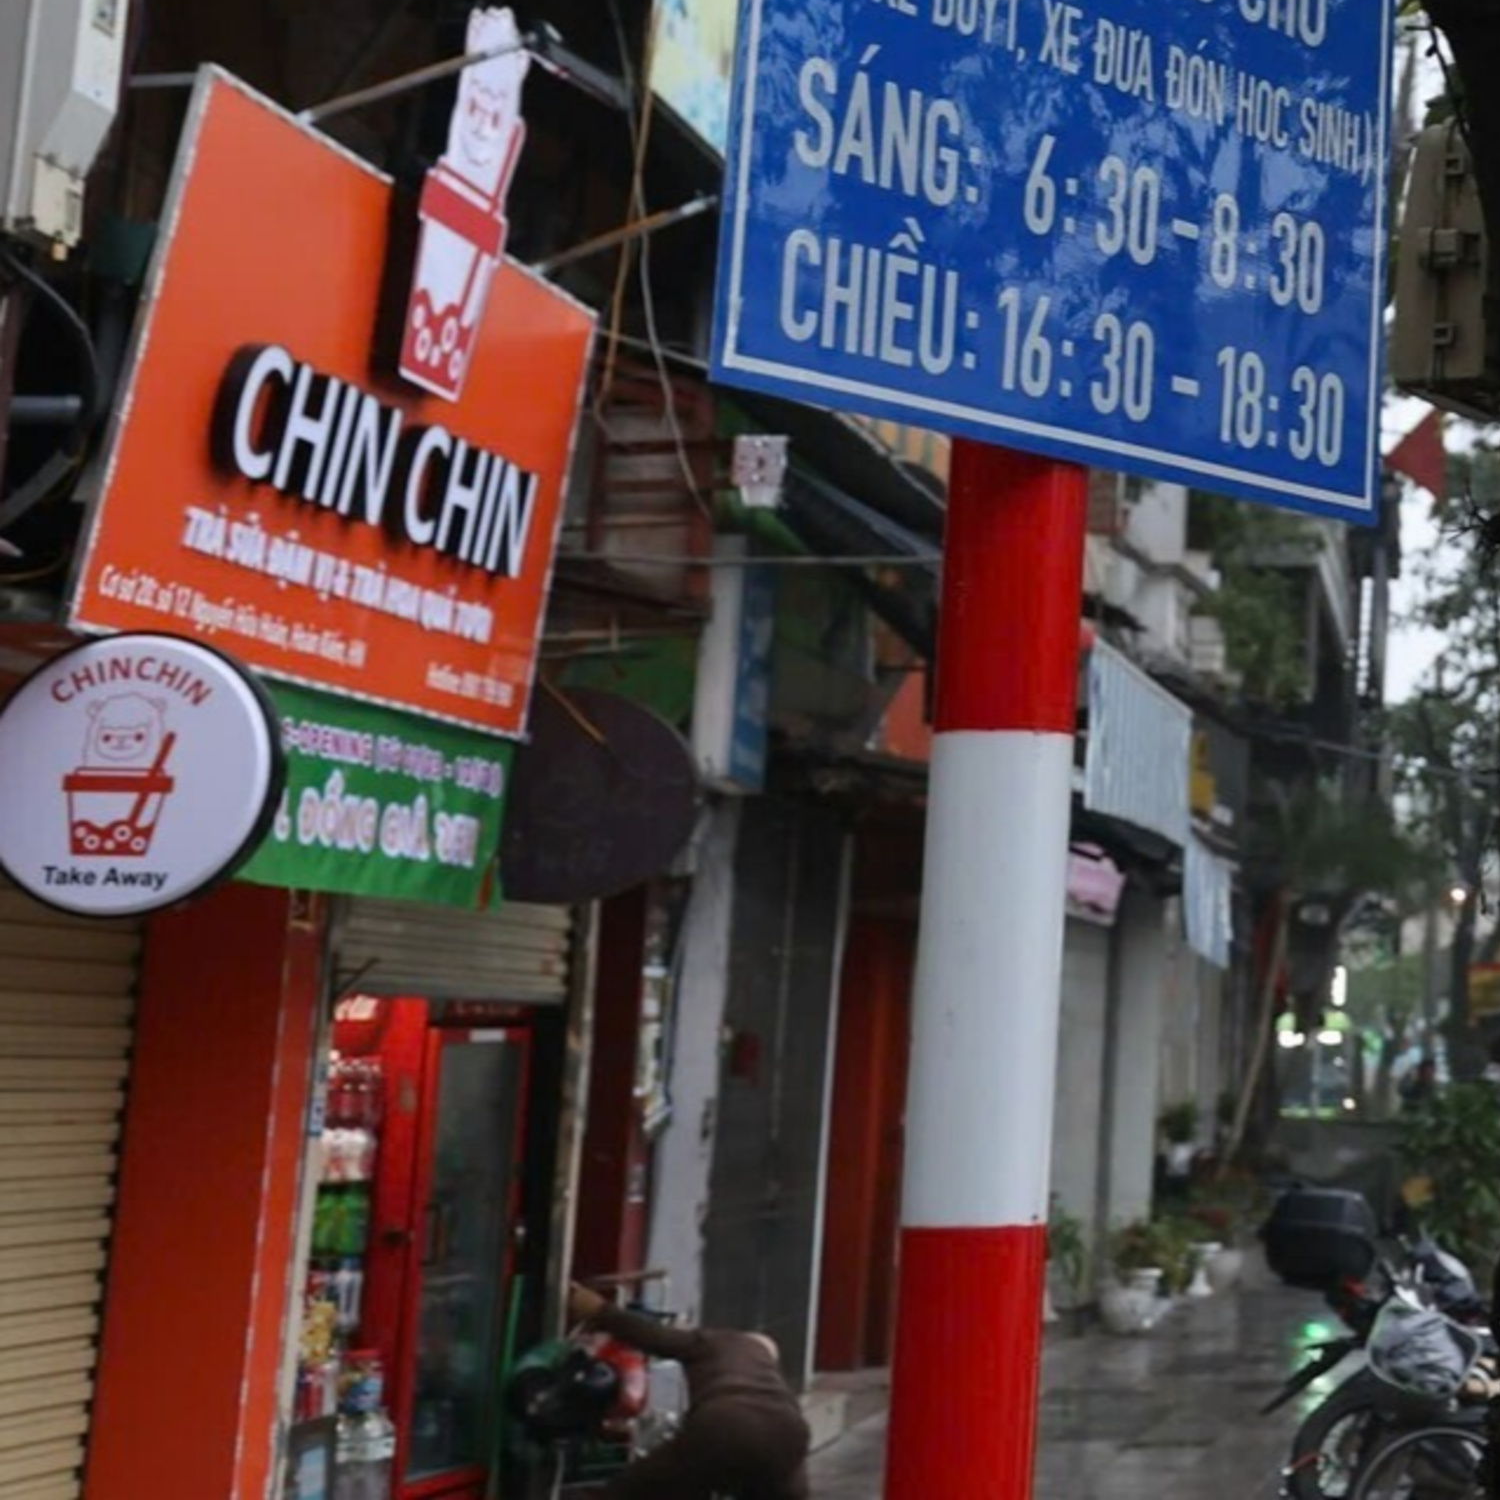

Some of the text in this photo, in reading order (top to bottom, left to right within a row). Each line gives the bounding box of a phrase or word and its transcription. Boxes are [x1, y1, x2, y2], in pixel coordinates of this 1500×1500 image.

[794, 43, 982, 207] SÁNG:
[1165, 39, 1225, 126] ĐÓN
[780, 217, 980, 375] CHIỀU:
[234, 345, 538, 579] CHIN CHIN
[51, 657, 212, 706] CHINCHIN
[43, 865, 168, 891] Take Away
